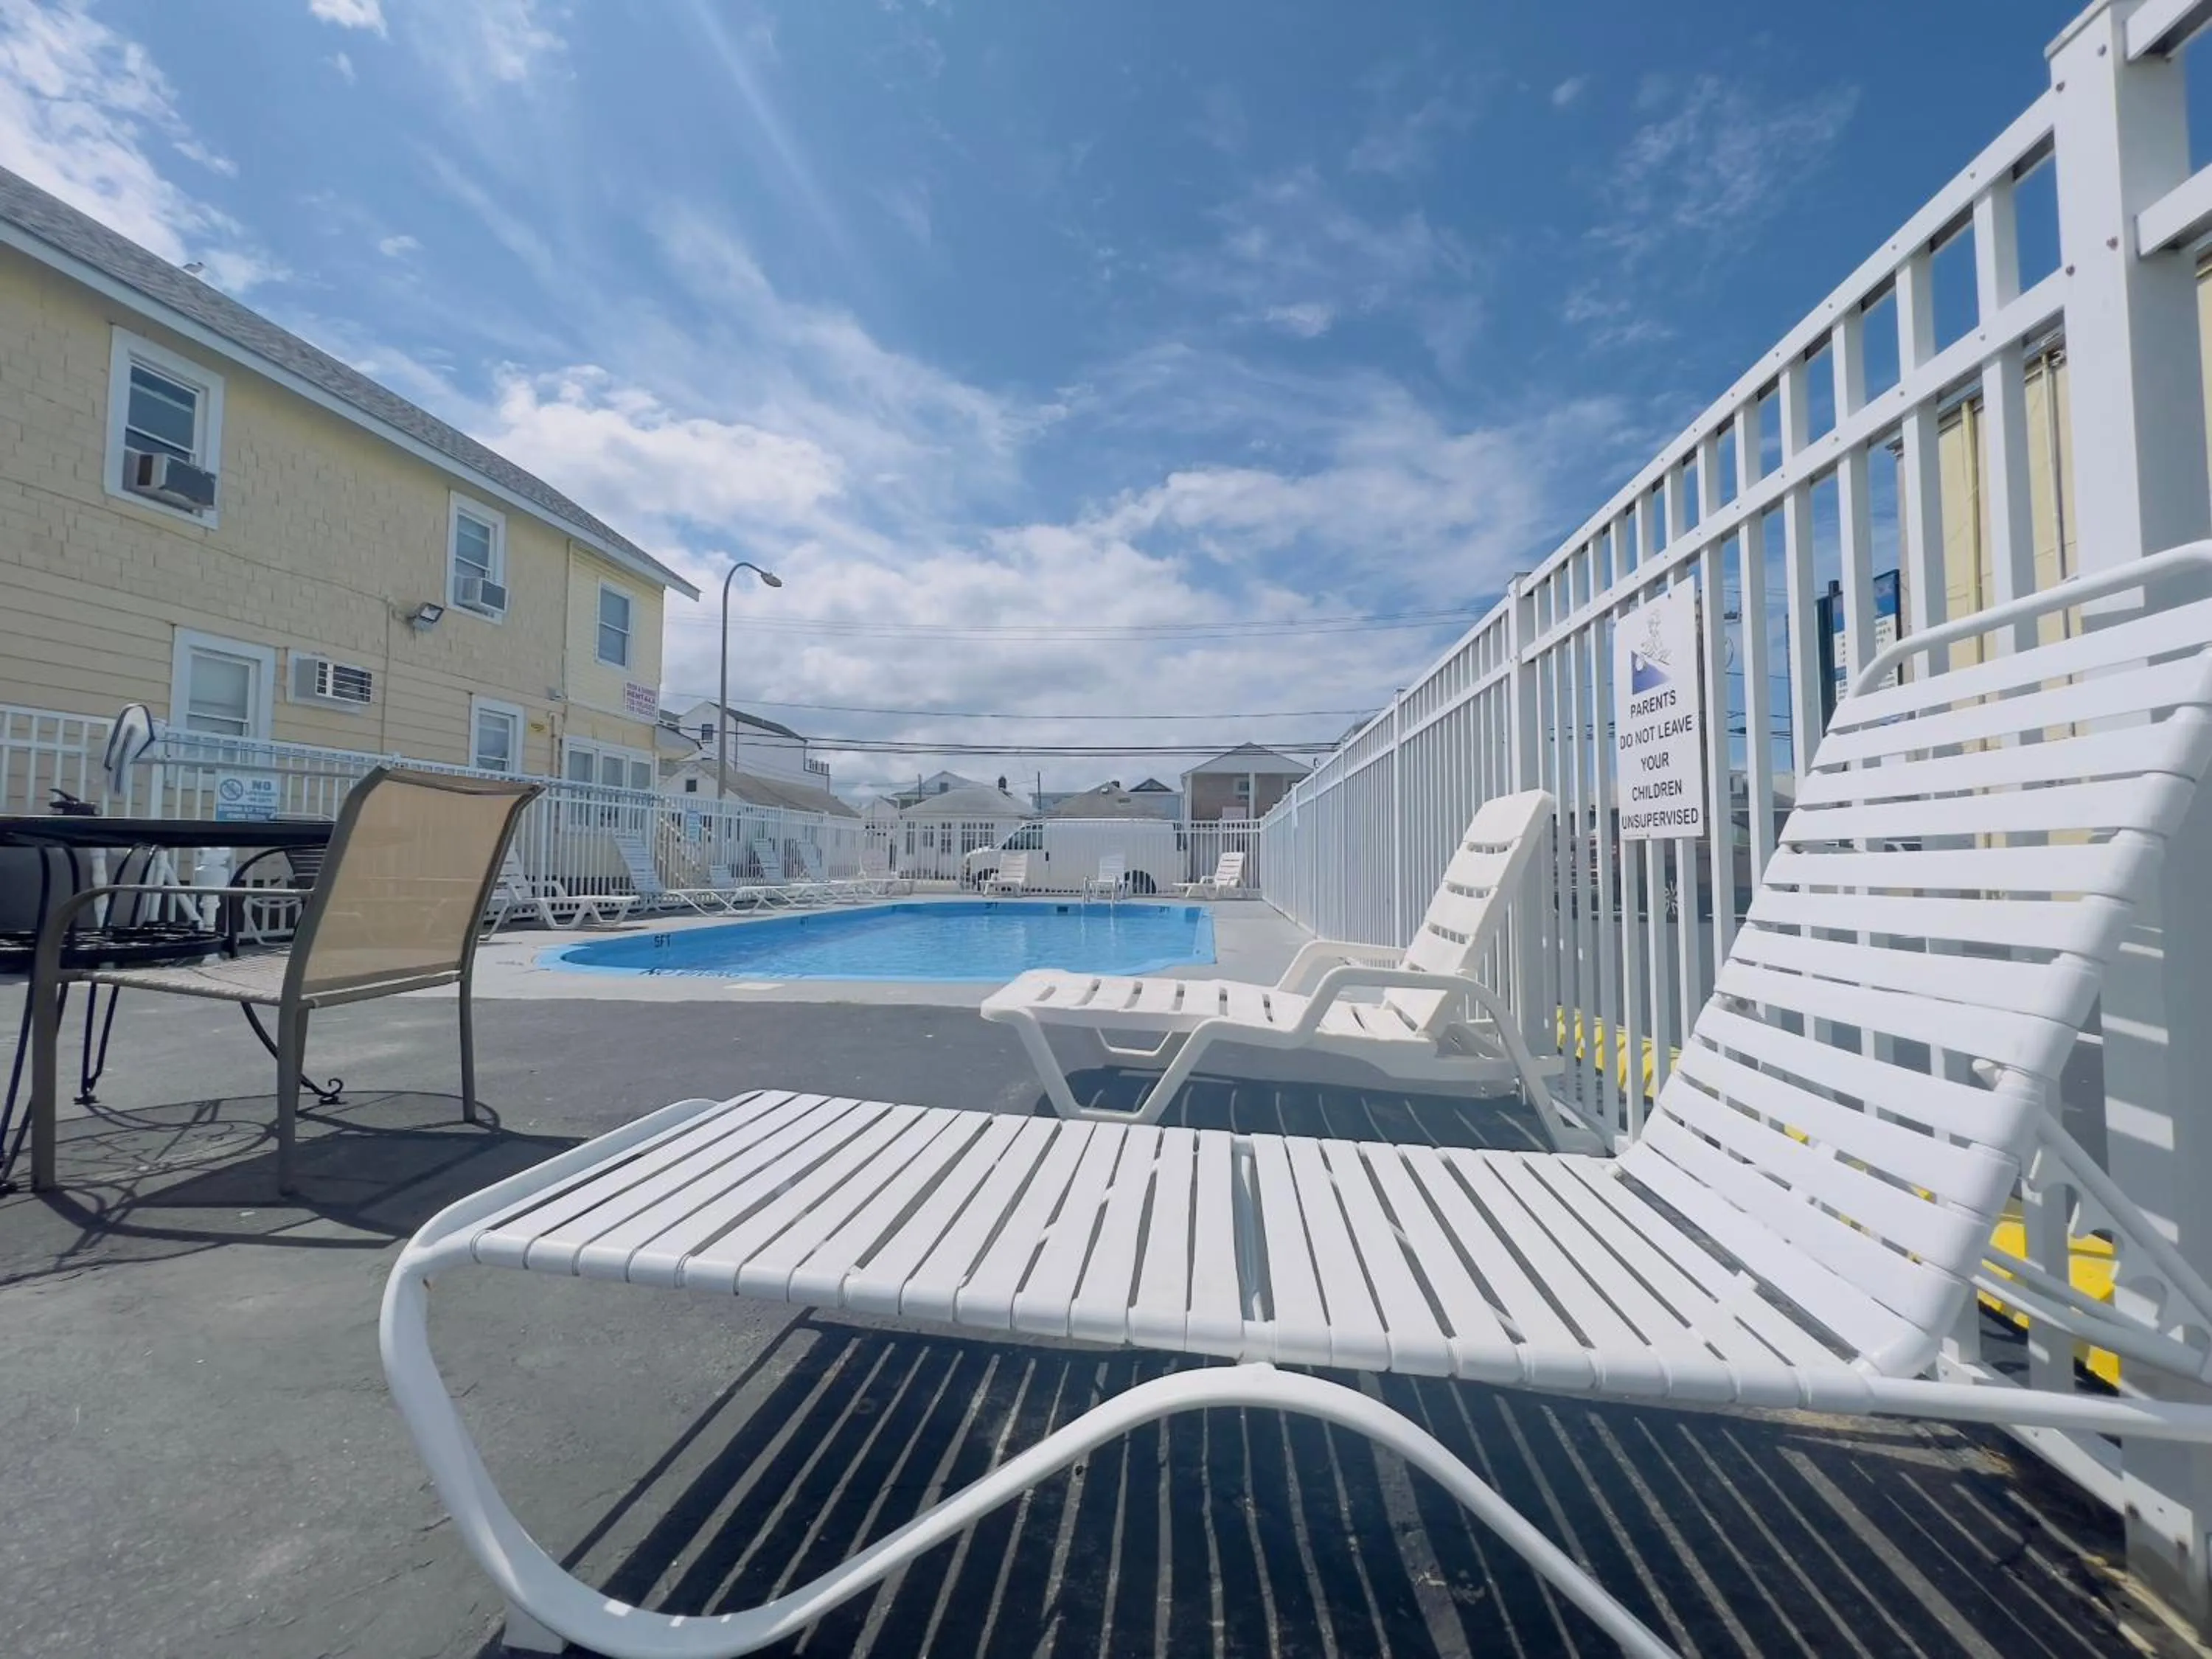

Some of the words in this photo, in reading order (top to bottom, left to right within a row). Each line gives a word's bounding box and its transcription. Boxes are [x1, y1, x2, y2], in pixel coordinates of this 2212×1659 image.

[1630, 689, 1676, 718] PARENTS
[1620, 733, 1633, 750] DO
[1635, 729, 1656, 746] NOT
[1658, 714, 1693, 740] LEAVE
[1641, 751, 1669, 772] YOUR
[251, 779, 272, 791] NO
[1632, 779, 1683, 801] CHILDREN
[1621, 807, 1699, 830] UNSUPERVISED
